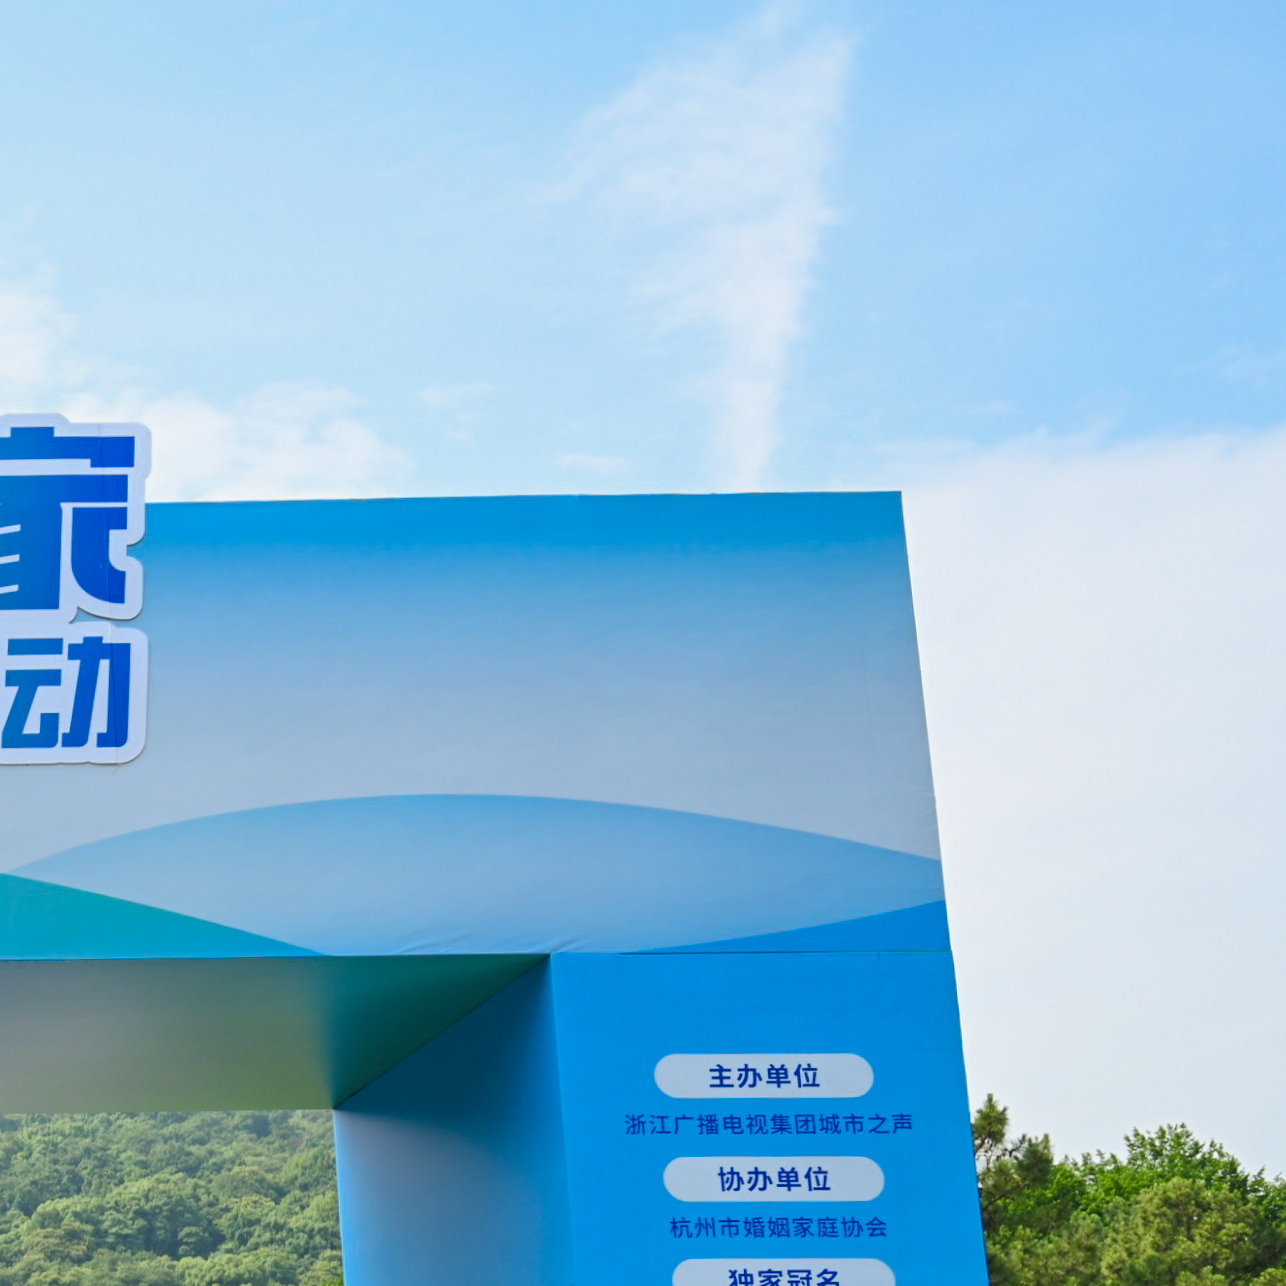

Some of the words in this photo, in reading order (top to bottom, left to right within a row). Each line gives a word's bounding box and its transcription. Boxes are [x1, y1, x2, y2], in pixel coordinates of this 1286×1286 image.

[709, 1063, 821, 1089] 主办单位
[624, 1113, 914, 1136] 浙江广播电视集团城市之声
[717, 1166, 831, 1192] 协办单位
[669, 1216, 888, 1239] 杭州市婚姻家庭协会
